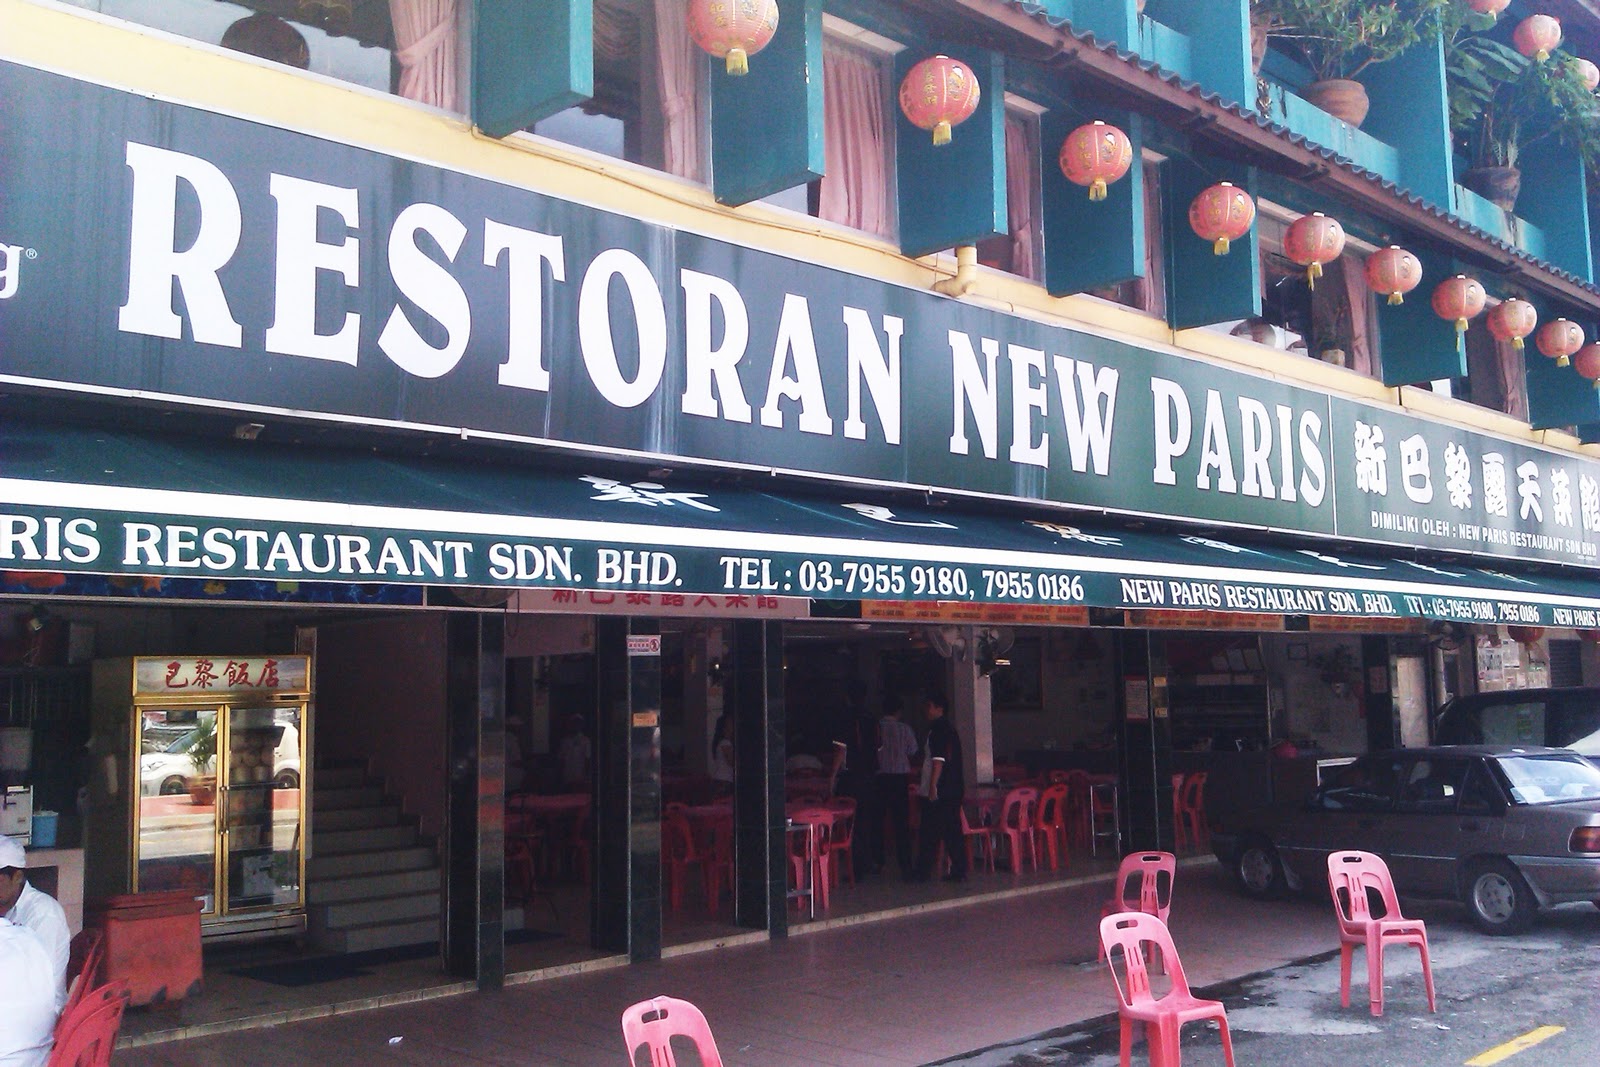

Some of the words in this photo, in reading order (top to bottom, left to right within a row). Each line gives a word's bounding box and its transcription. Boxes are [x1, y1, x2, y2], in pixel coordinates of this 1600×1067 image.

[118, 141, 904, 445] RESTORAN
[948, 330, 1119, 476] NEW
[1150, 377, 1326, 507] PARIS
[1371, 510, 1418, 533] DIMILIKI
[1422, 517, 1450, 537] OLEH
[1459, 523, 1480, 542] NEW
[1482, 527, 1508, 546] PARIS
[1510, 531, 1563, 552] RESTAURANT
[122, 522, 474, 578] RESTAURANT
[489, 543, 582, 582] SDN.
[596, 548, 682, 587] BHD.
[799, 560, 906, 594] 03-7955
[910, 565, 975, 600] 9180,
[981, 570, 1034, 599] 7955
[1037, 574, 1085, 601] 0186
[1120, 578, 1165, 605] NEW
[1169, 581, 1222, 608] PARIS
[1223, 585, 1327, 612] RESTAURANT
[1328, 591, 1362, 613] SDN.
[1362, 593, 1397, 614] BHD.
[1432, 598, 1472, 618] 03-7955
[1498, 603, 1519, 622] 7955
[1519, 604, 1540, 623] 0186
[1553, 607, 1573, 626] NEW
[1573, 609, 1597, 627] PARIS
[165, 659, 280, 689] 巴黎飯店
